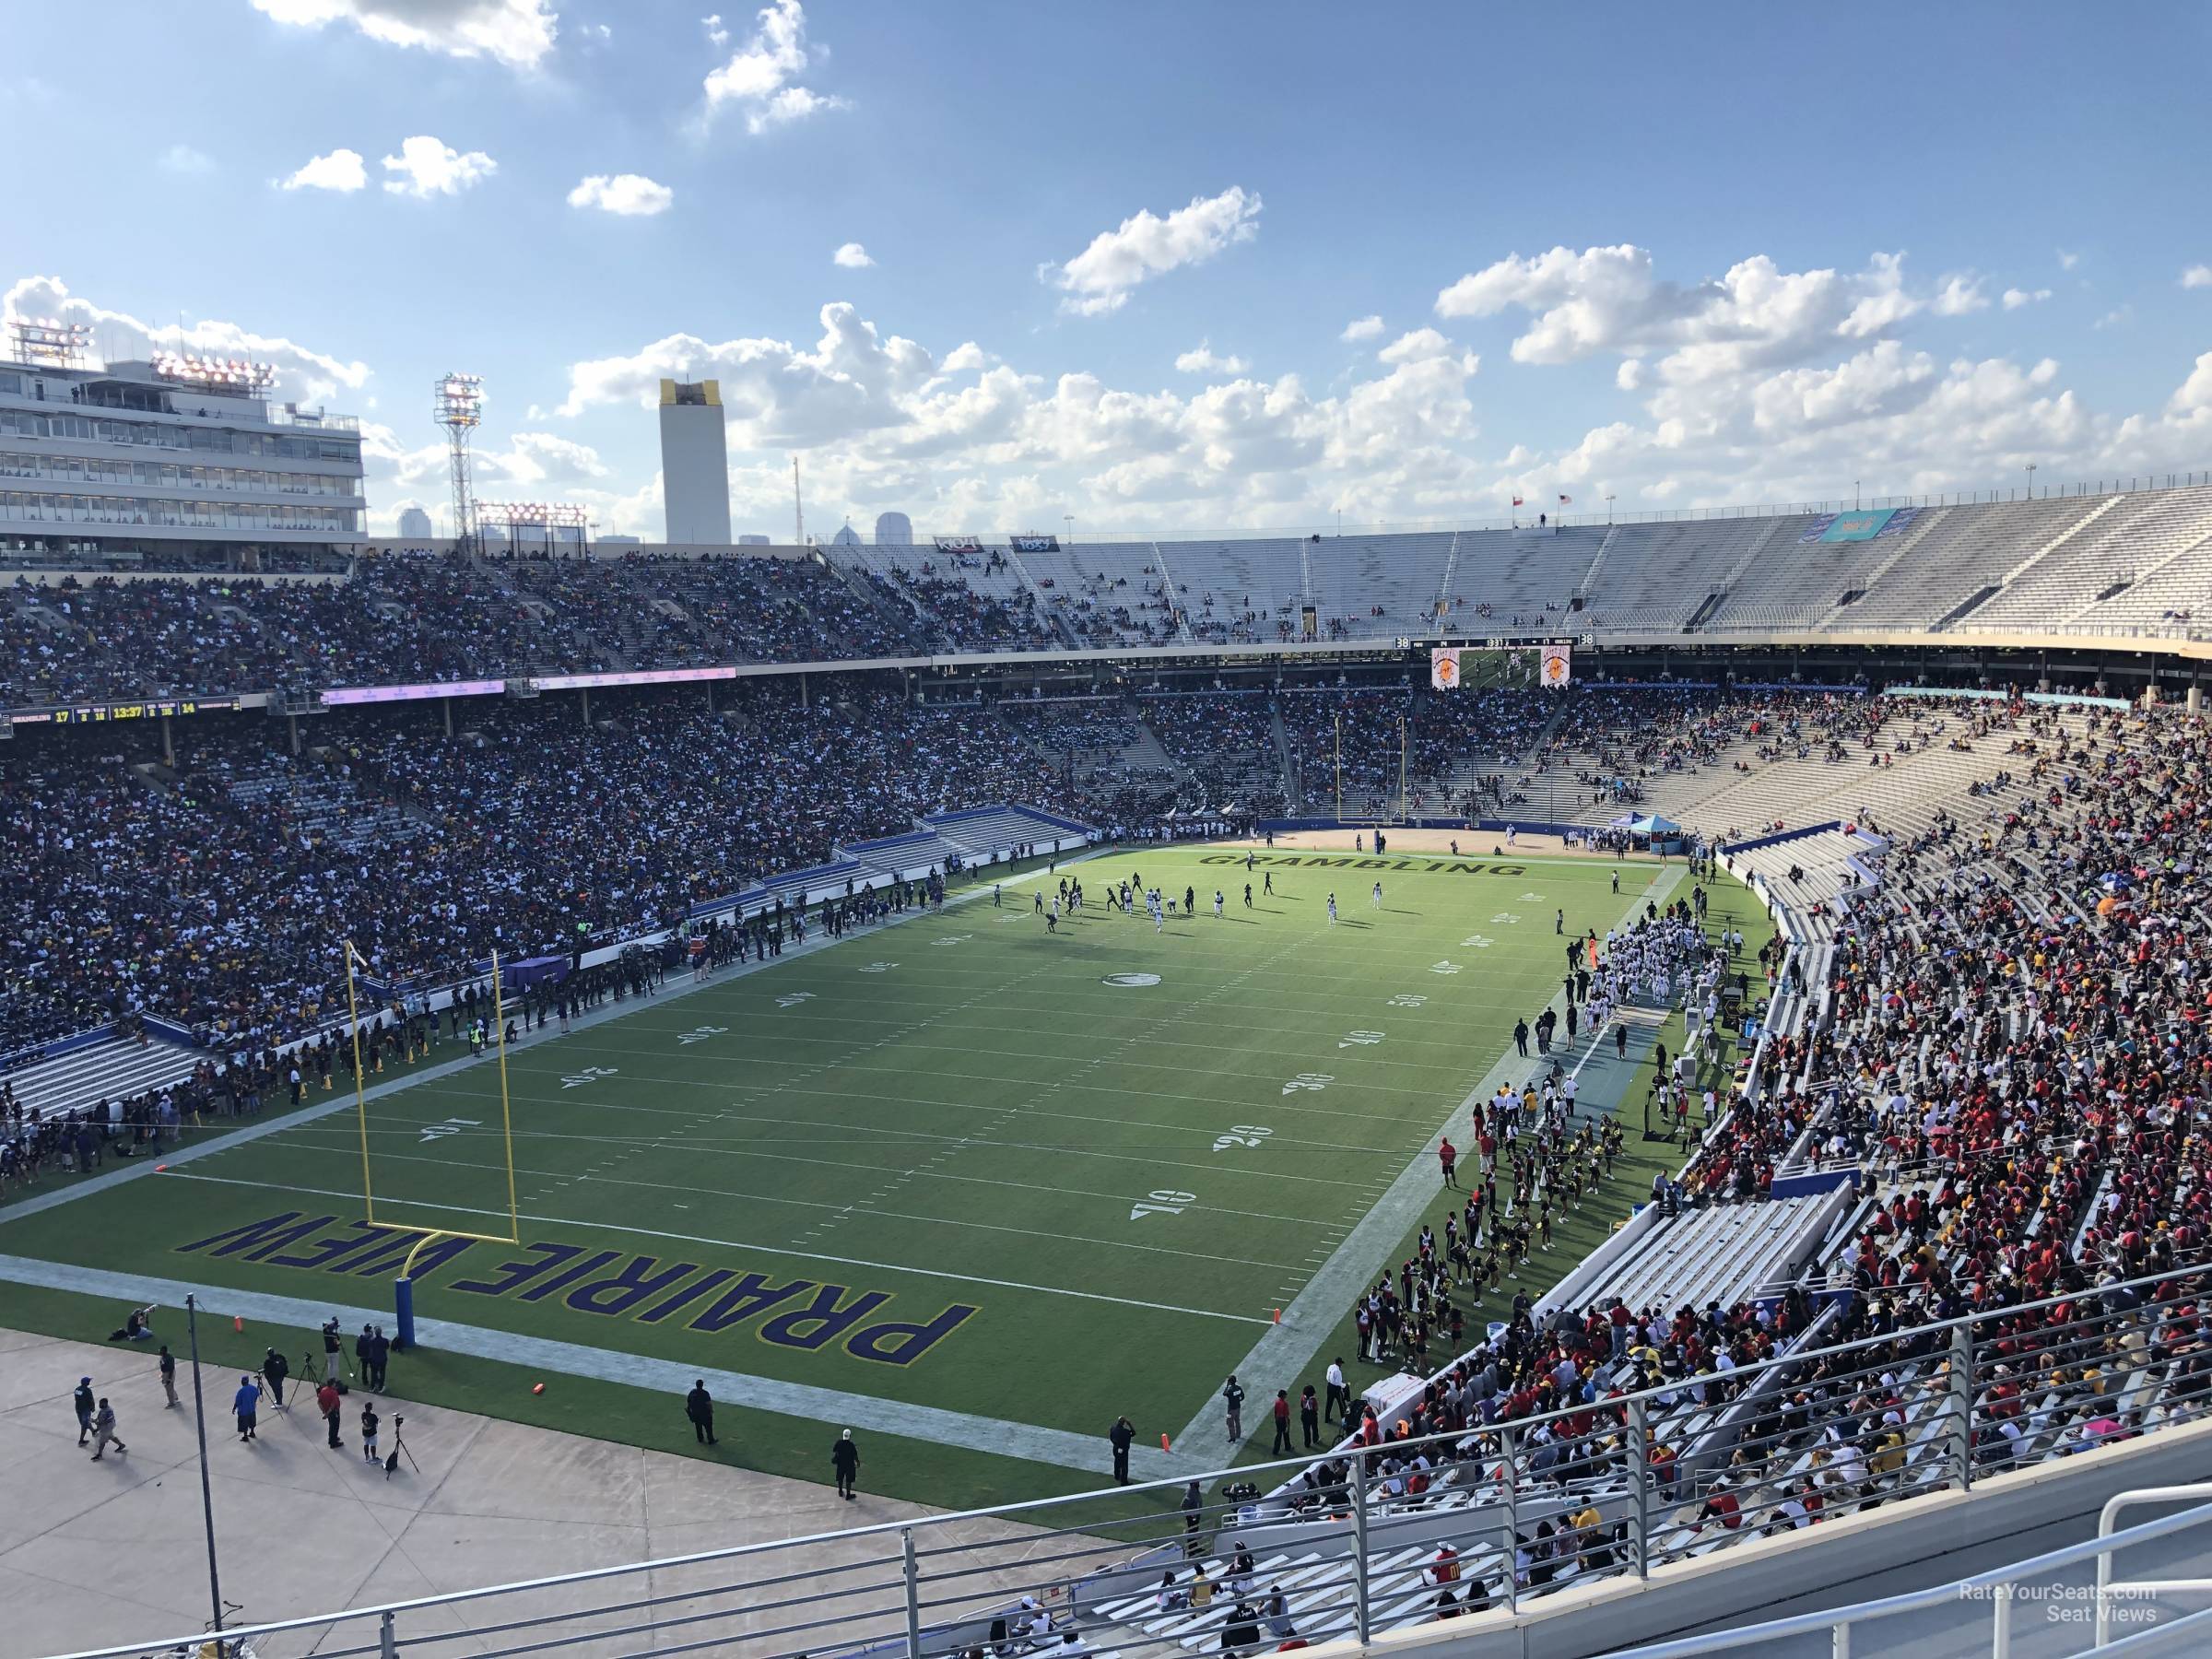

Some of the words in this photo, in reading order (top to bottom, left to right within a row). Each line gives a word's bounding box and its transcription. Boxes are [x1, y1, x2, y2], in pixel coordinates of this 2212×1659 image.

[1396, 638, 1409, 648] 38
[1581, 633, 1594, 644] 38
[113, 707, 143, 718] 13:37
[182, 702, 195, 713] 14
[56, 711, 69, 723] 17
[1200, 854, 1527, 876] GRAMBLING
[677, 1026, 729, 1041] 30
[1343, 1030, 1385, 1045] 40
[560, 1067, 618, 1085] 20
[1285, 1073, 1335, 1091] 30
[420, 1118, 484, 1135] 10
[1215, 1125, 1275, 1147] 20
[1133, 1190, 1196, 1215] 10
[171, 1211, 479, 1284] VIEW
[446, 1241, 982, 1368] PRAIRIE
